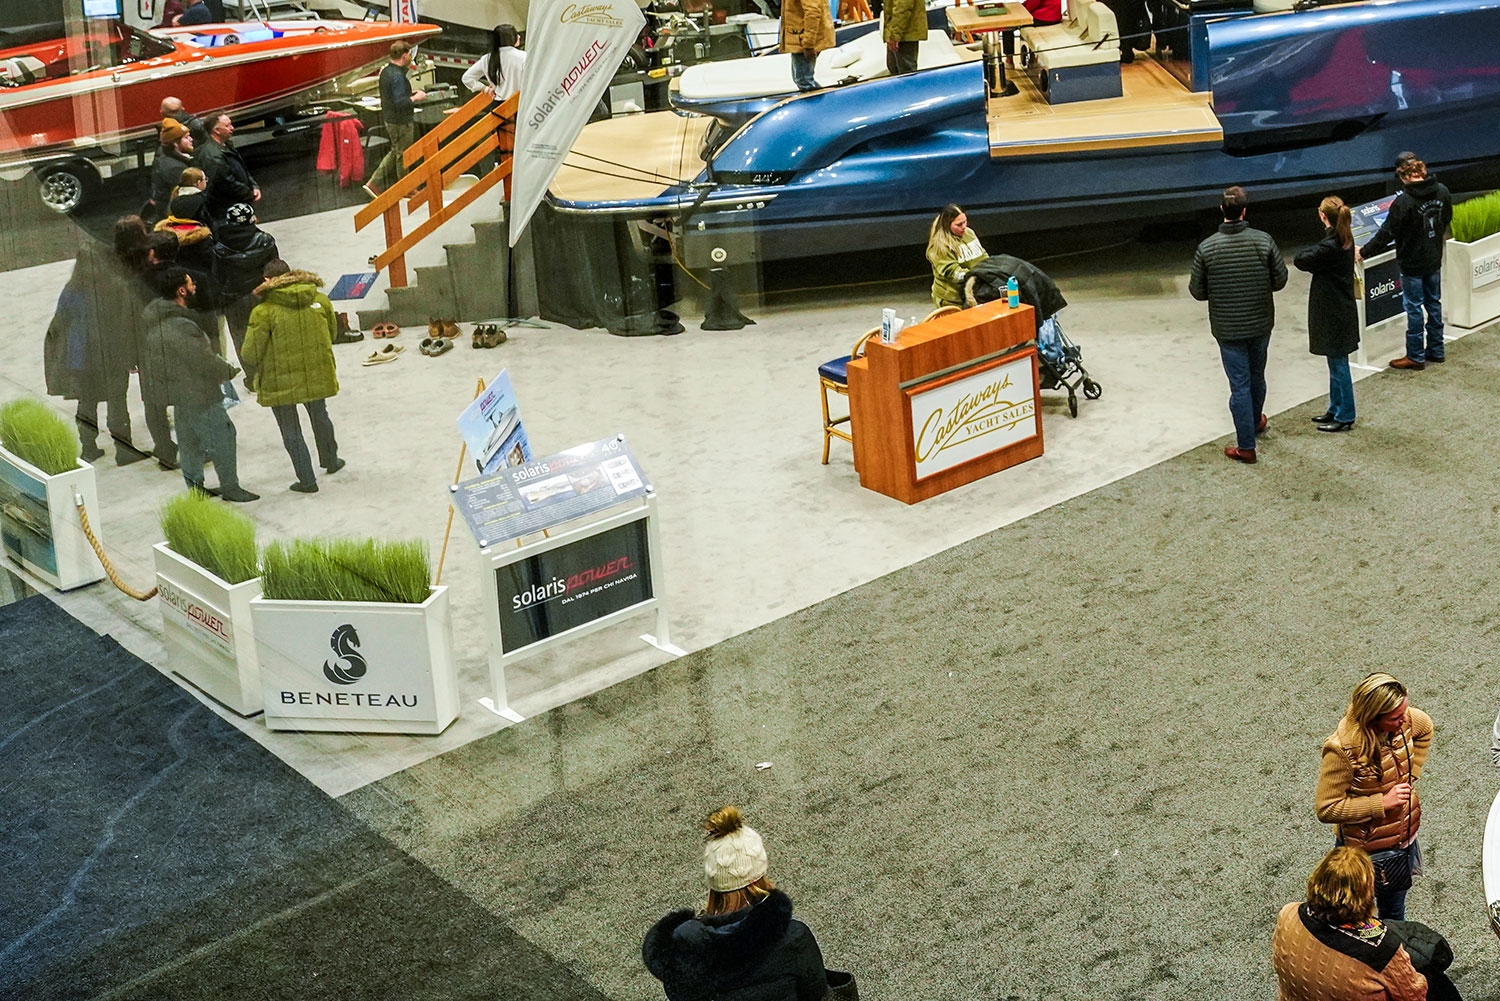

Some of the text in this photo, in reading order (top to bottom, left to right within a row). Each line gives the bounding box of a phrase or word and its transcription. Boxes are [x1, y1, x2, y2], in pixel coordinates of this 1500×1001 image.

[560, 3, 613, 24] Castaways
[528, 85, 565, 131] solaris
[1474, 256, 1499, 277] solaris
[1369, 279, 1395, 299] solaris
[915, 373, 1014, 464] Castaways
[966, 402, 1034, 435] YACHT SALES
[512, 462, 550, 482] solaris
[158, 583, 188, 611] solaris
[512, 576, 566, 610] solaris
[561, 596, 575, 605] DAL
[575, 591, 590, 600] 1974
[590, 585, 603, 594] PER
[615, 573, 637, 586] NAVIGA
[280, 691, 418, 708] BENETEAU
